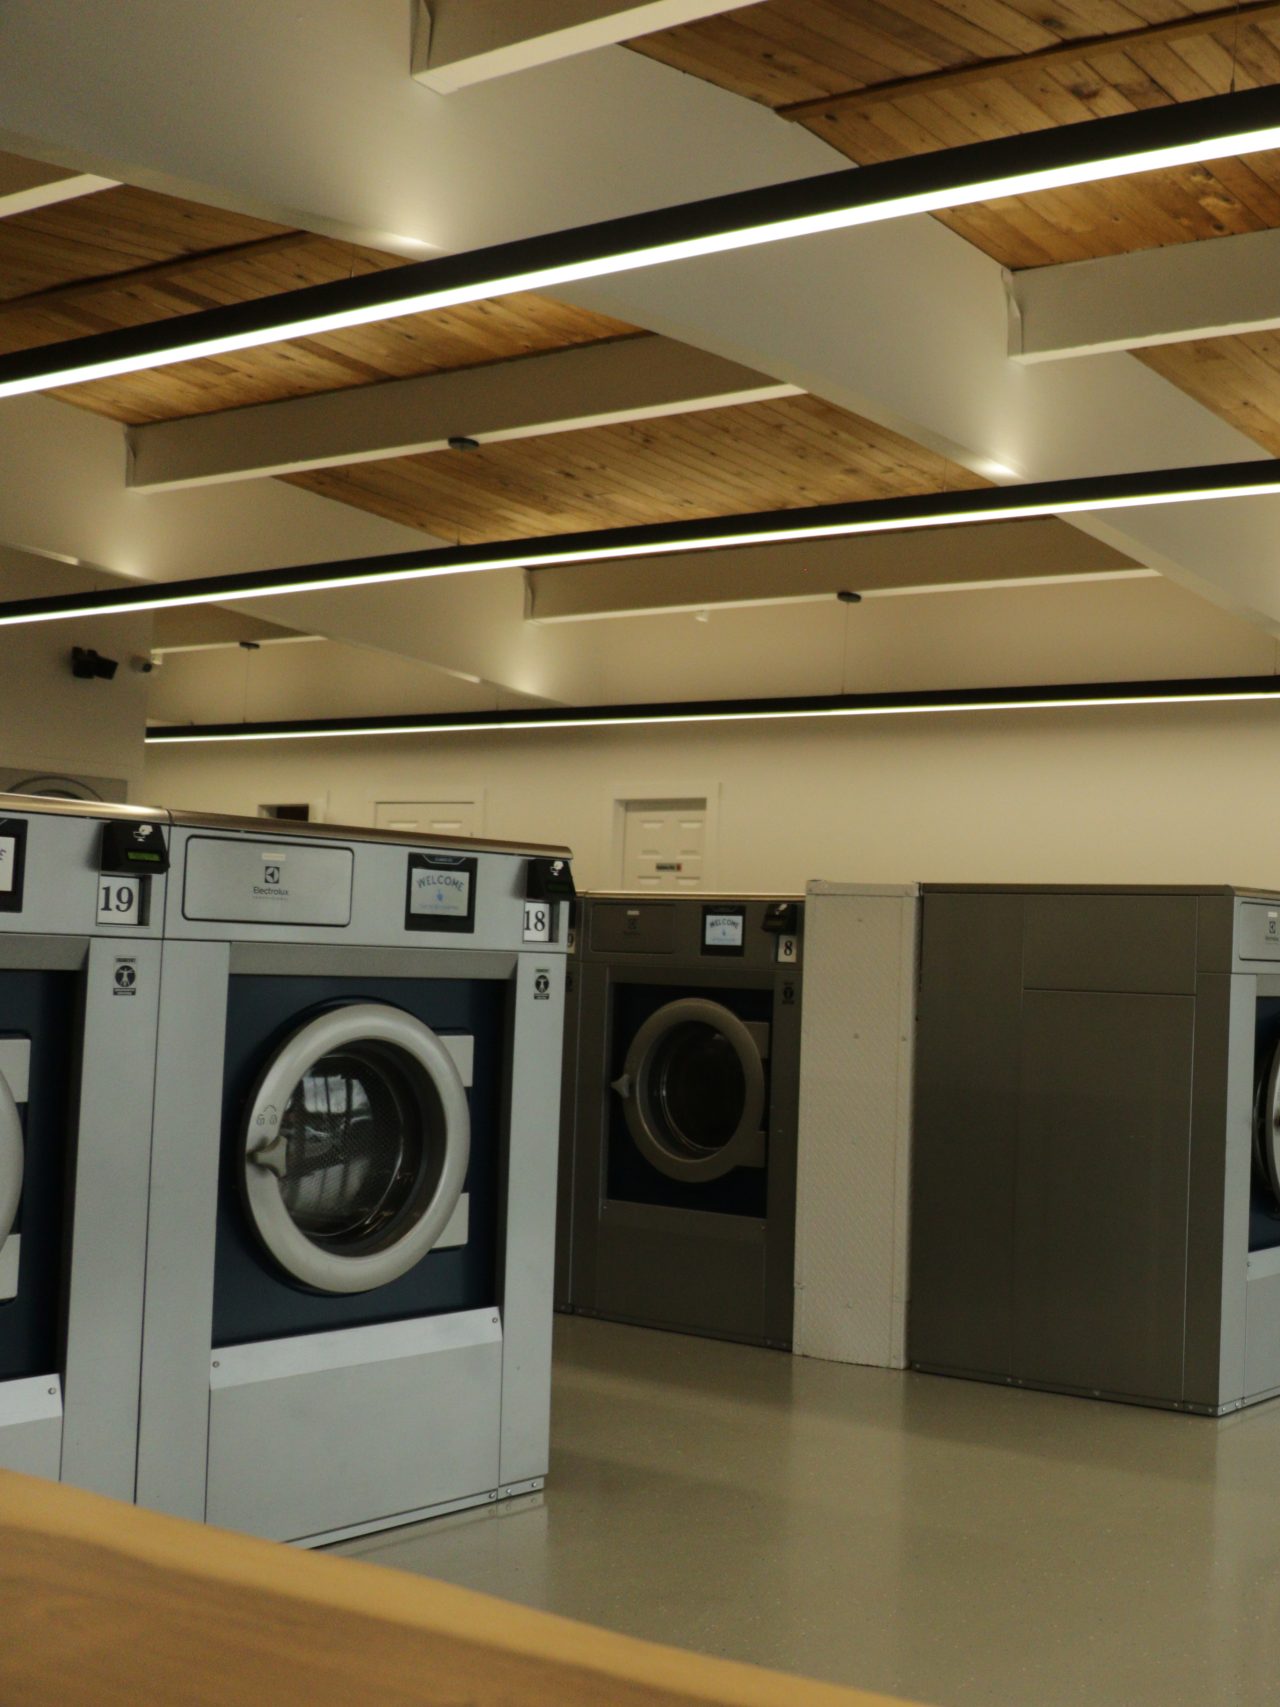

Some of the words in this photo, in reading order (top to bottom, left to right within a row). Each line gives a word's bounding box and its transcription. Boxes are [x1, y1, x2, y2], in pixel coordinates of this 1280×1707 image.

[254, 886, 289, 896] Electrolux
[417, 875, 465, 892] WELCOME
[100, 886, 134, 913] 19
[524, 910, 546, 932] 18
[710, 918, 739, 930] WELCOME
[783, 940, 793, 956] 8
